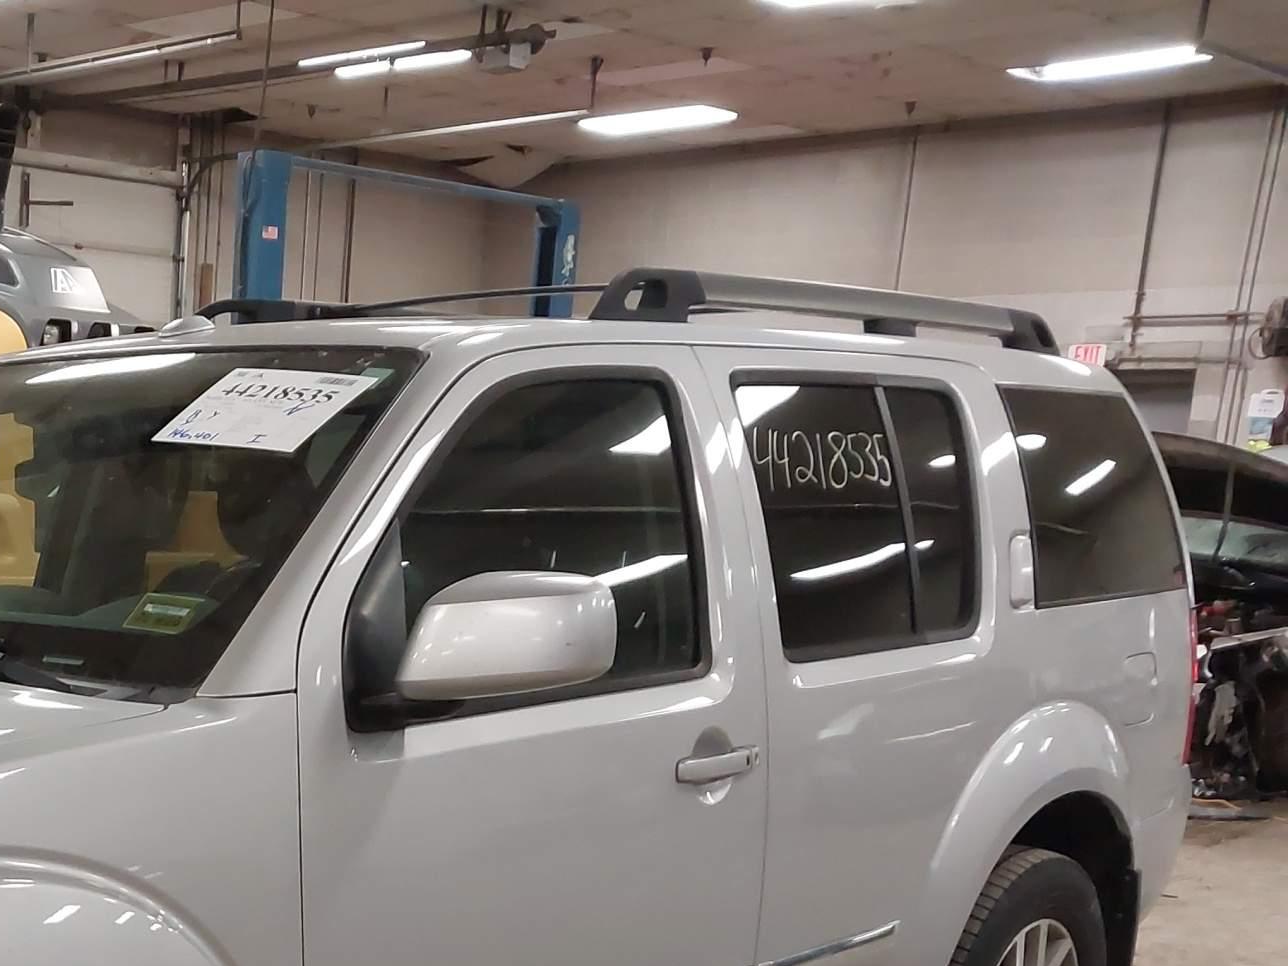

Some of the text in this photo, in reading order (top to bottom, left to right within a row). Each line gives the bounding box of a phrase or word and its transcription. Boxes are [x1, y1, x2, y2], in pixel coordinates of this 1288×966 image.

[1074, 345, 1102, 366] EXIT
[221, 382, 341, 403] 44218535
[753, 427, 892, 492] 44218535
